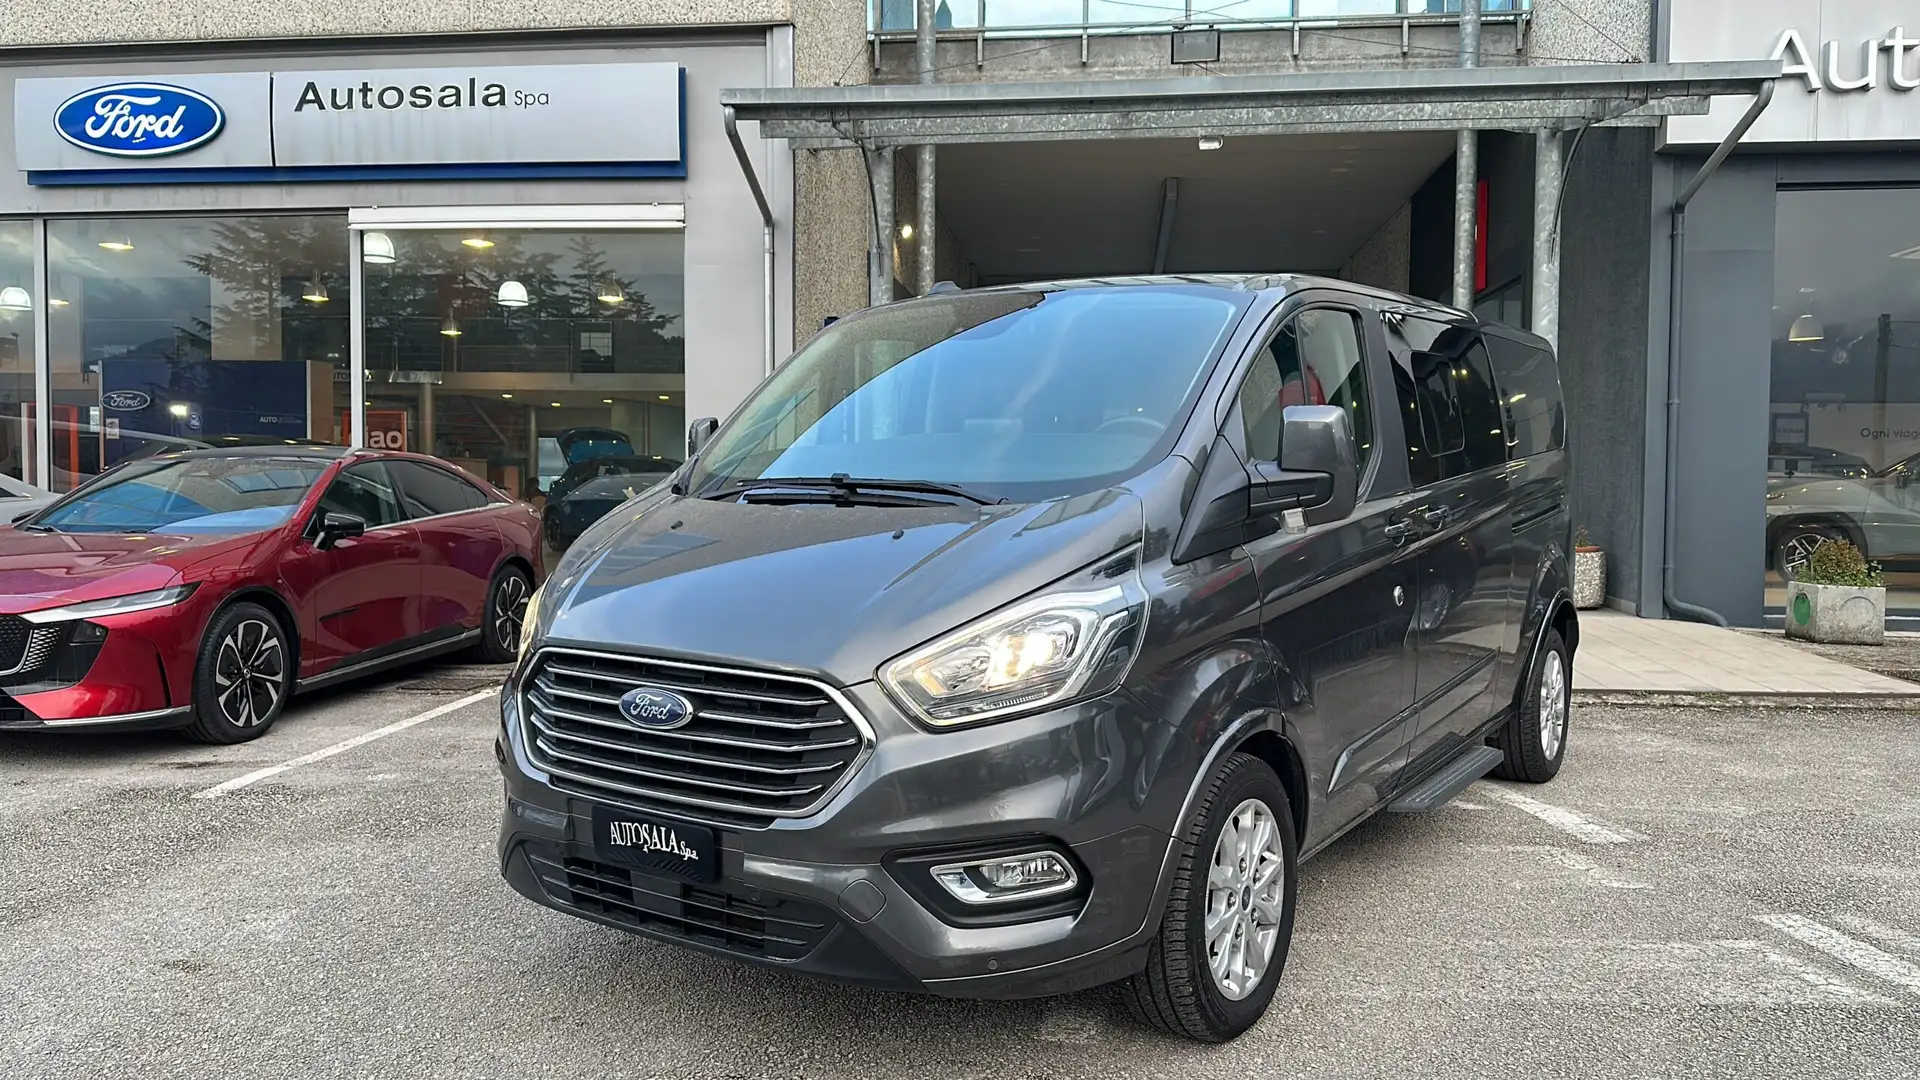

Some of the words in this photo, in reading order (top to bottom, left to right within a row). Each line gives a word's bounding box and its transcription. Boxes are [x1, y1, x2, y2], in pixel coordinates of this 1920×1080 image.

[294, 77, 508, 113] Autosala
[514, 89, 550, 109] Spa
[85, 94, 187, 139] Ford
[110, 393, 141, 407] Ford
[1860, 427, 1890, 440] Ogni
[630, 693, 672, 719] Ford
[610, 821, 680, 854] AUTOSALA
